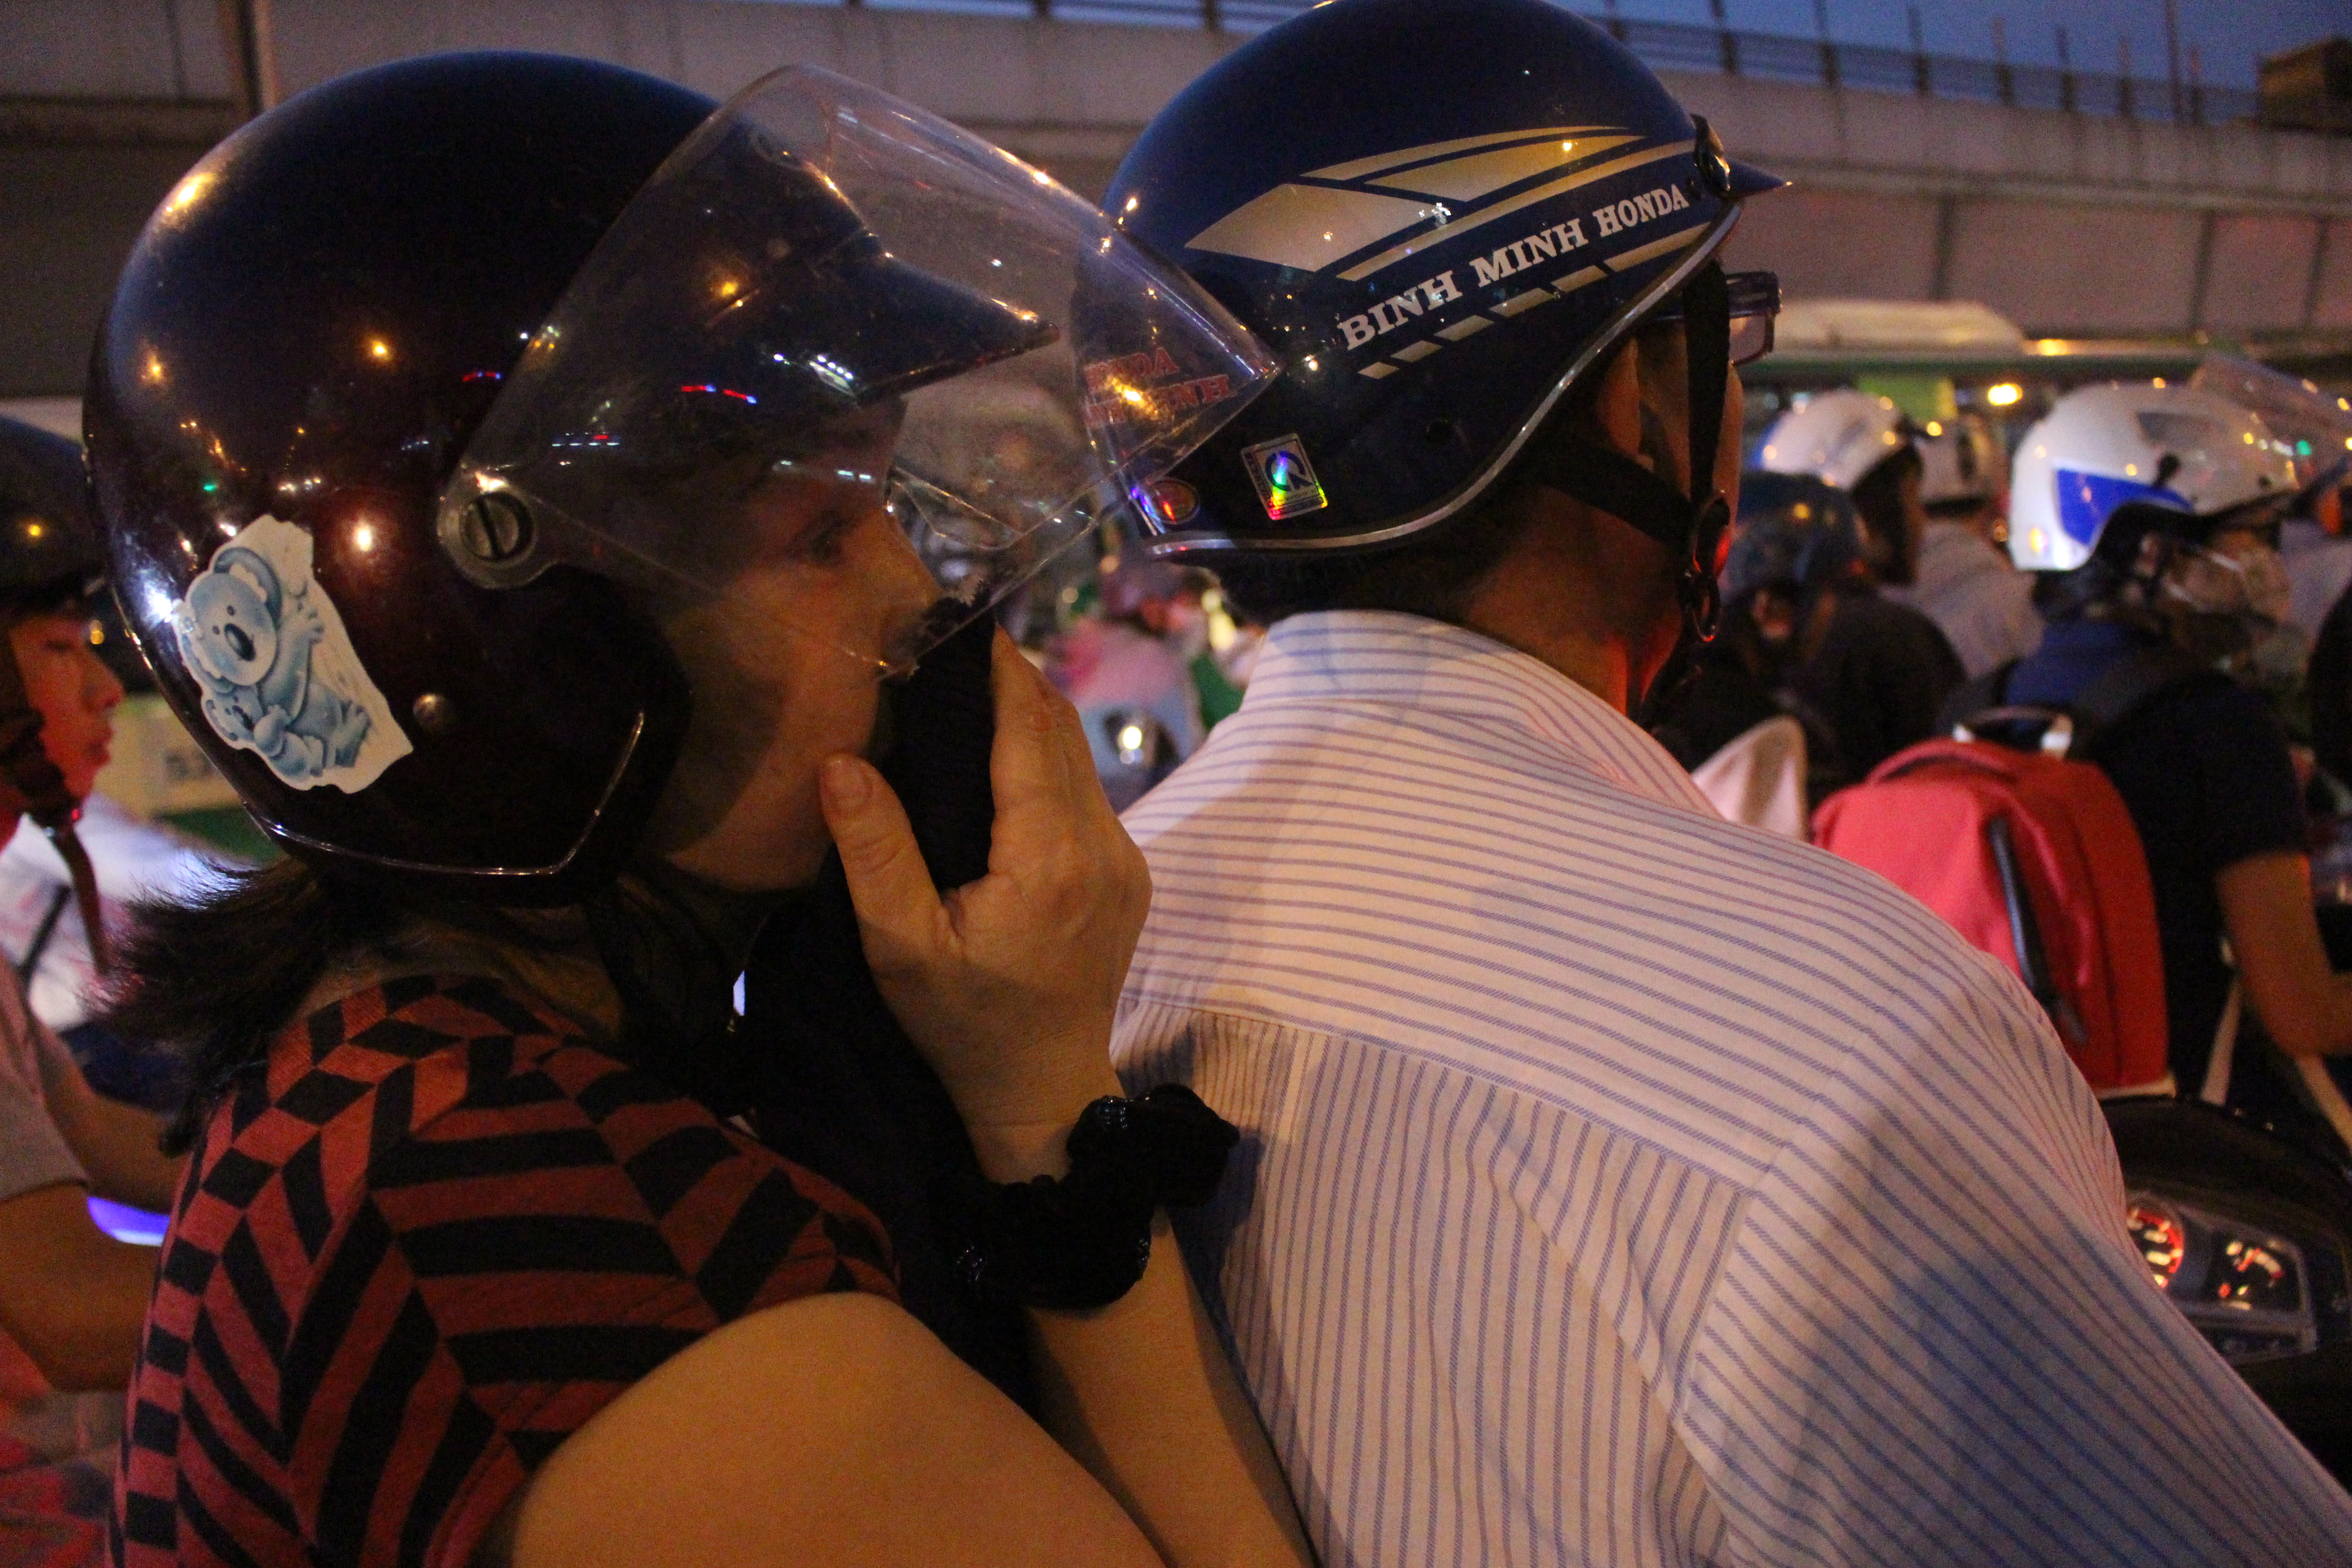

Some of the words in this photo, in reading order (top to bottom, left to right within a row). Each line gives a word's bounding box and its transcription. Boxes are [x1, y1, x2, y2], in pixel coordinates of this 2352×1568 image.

[1338, 270, 1463, 350] BINH
[1469, 218, 1588, 287] MINH
[1592, 184, 1689, 237] HONDA
